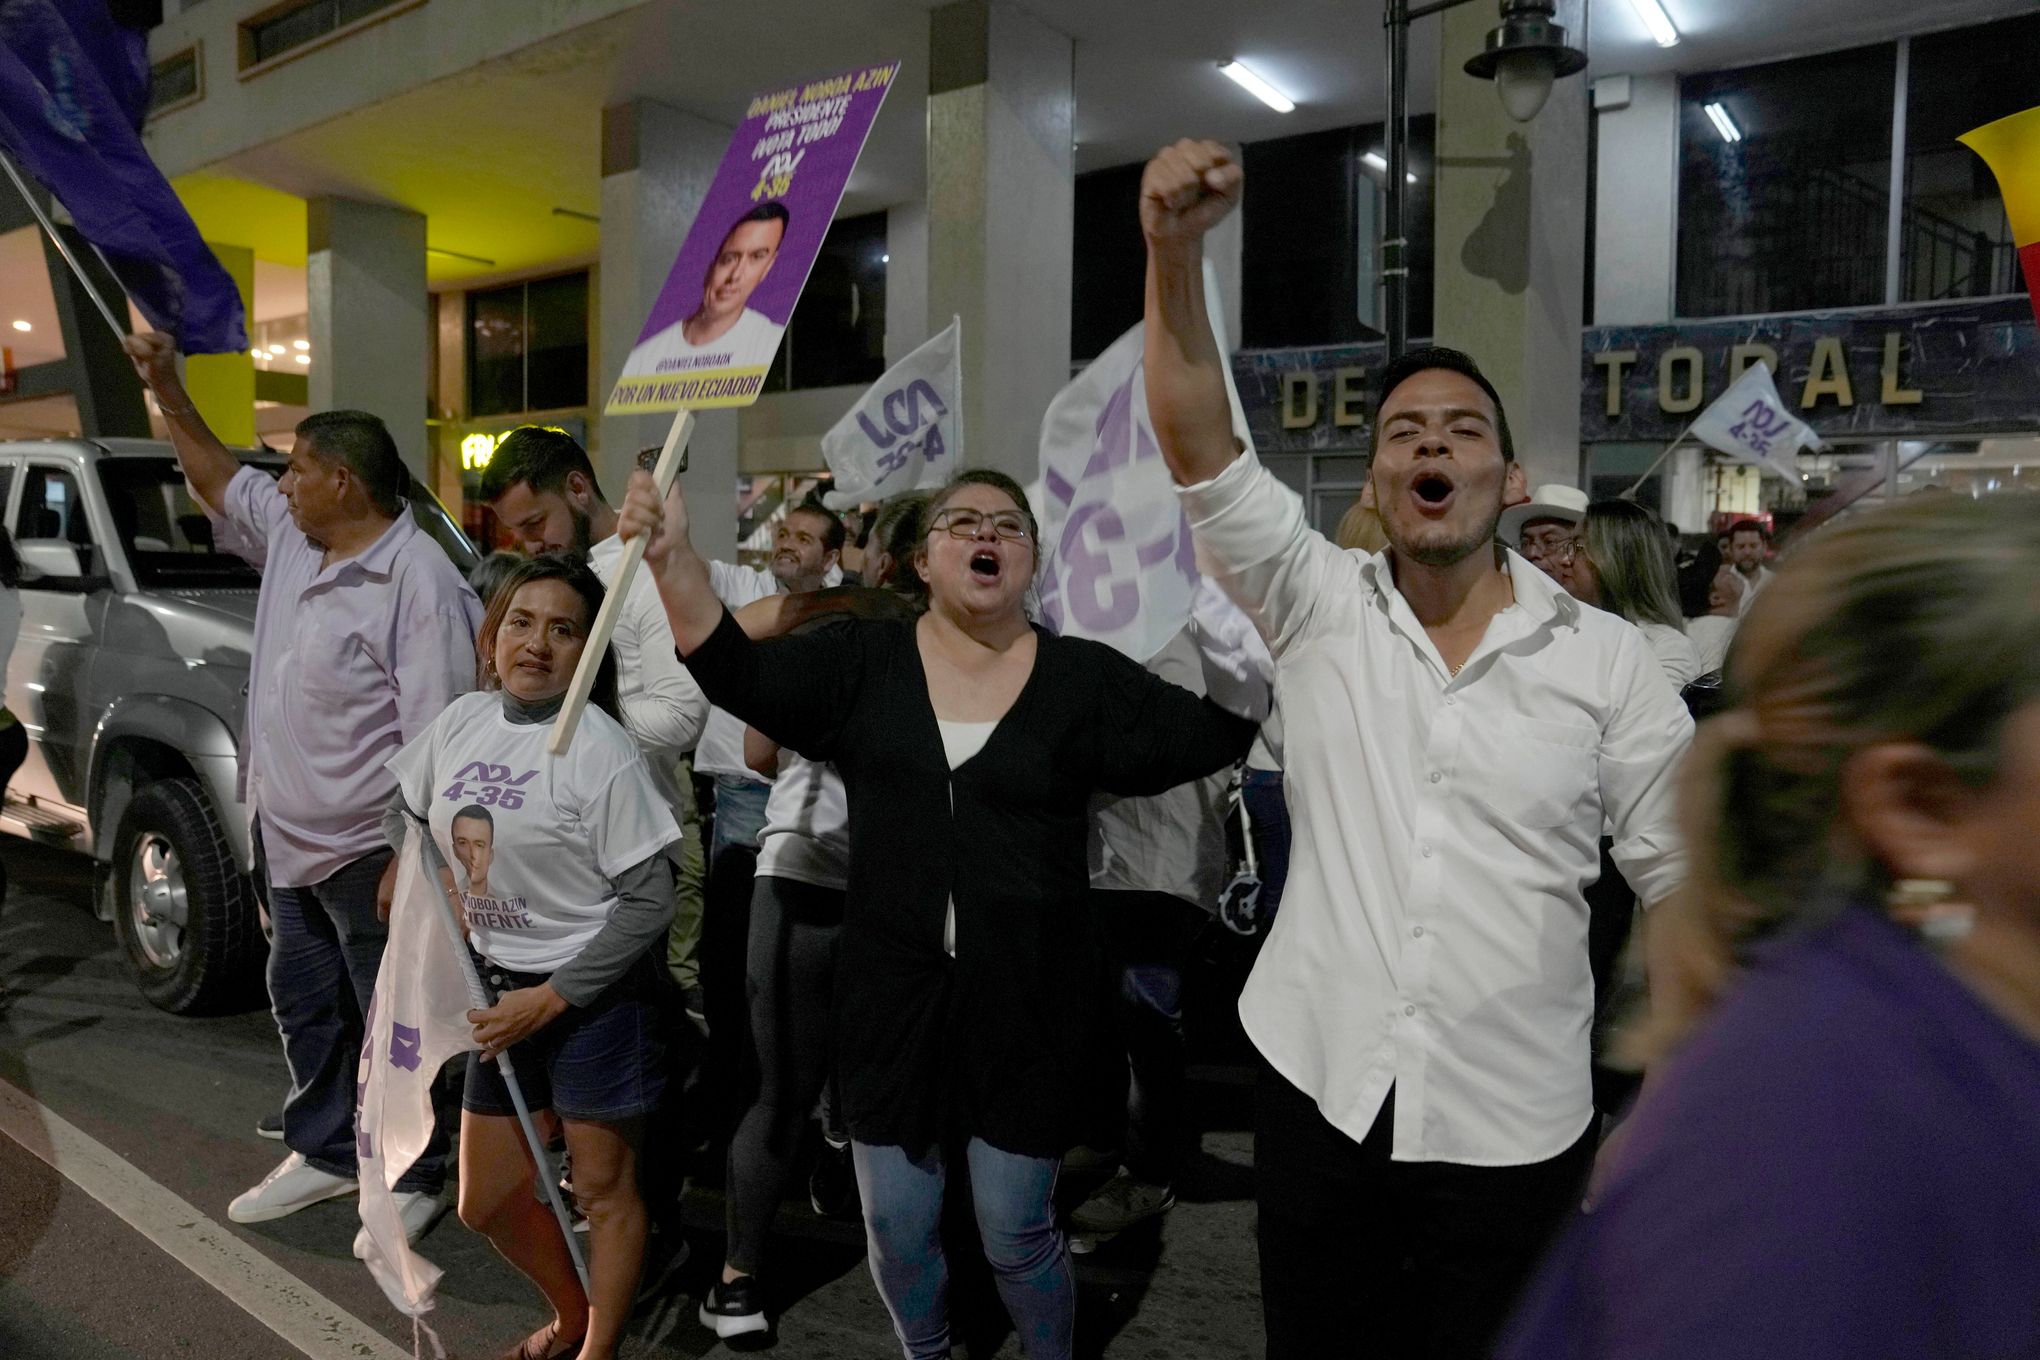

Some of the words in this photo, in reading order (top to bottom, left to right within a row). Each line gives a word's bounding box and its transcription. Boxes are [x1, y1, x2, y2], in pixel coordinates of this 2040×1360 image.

[799, 73, 853, 102] NOBOA
[765, 94, 852, 133] PRESIDENTE
[610, 385, 637, 406] POR
[637, 384, 658, 404] UN
[656, 380, 700, 402] NUEVO
[699, 375, 763, 399] ECUADOR
[442, 781, 527, 811] 4-35
[501, 895, 528, 913] AZIN
[464, 910, 537, 929] IDENTE
